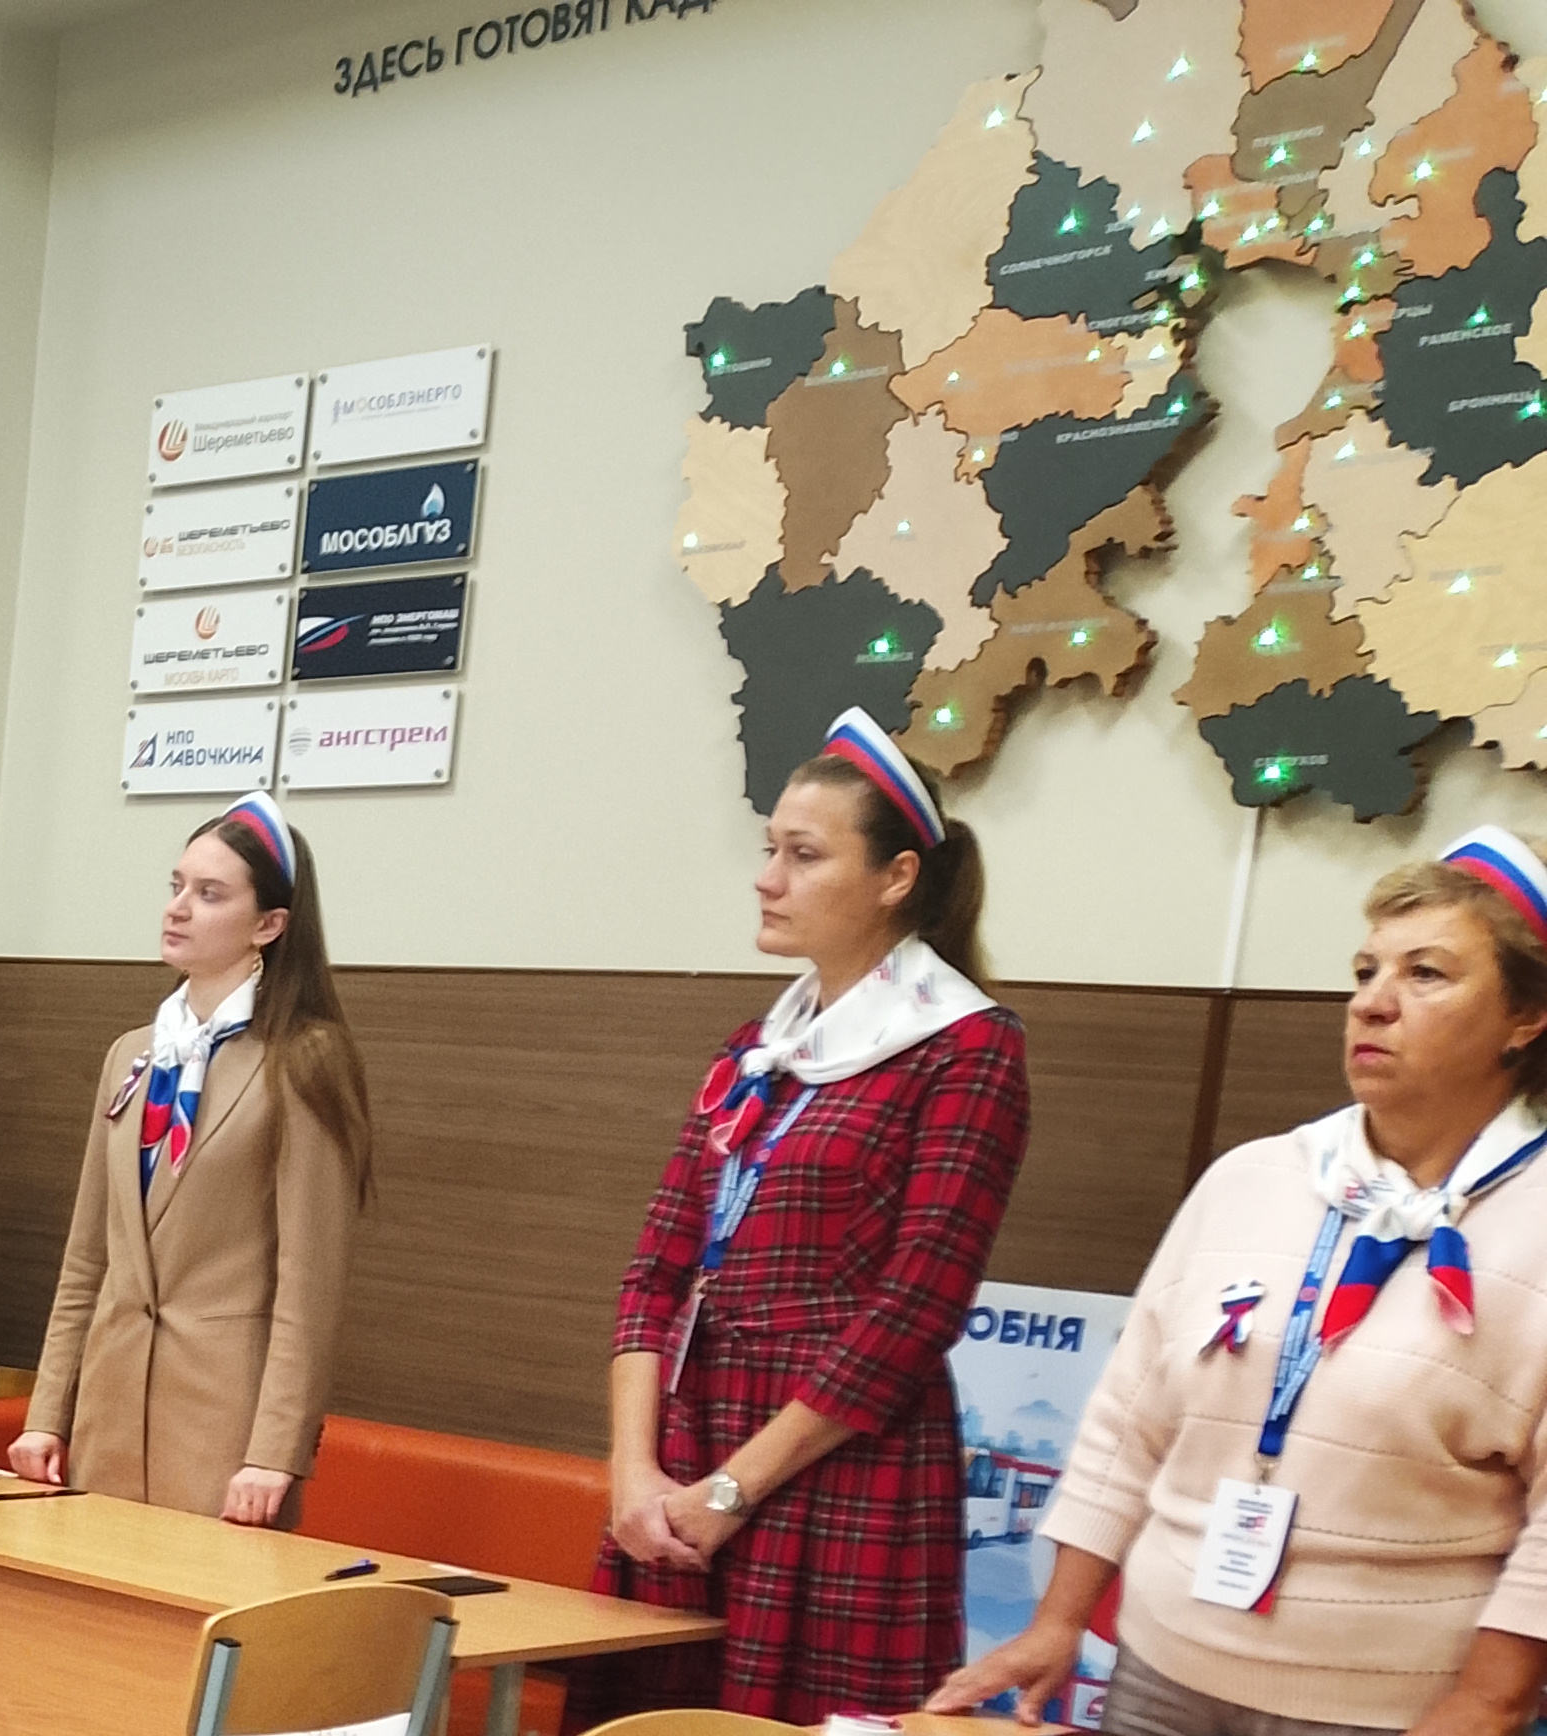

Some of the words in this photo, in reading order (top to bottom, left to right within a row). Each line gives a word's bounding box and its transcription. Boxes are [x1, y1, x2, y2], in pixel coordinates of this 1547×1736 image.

[334, 36, 444, 98] ЗДЕСЬ
[455, 0, 610, 65] ГОТОВЯТ
[1418, 322, 1515, 347] РАМЕНСКОЕ
[342, 384, 463, 414] МОСОБЛЭНЕРГО
[193, 426, 294, 453] Шереметьево
[178, 519, 290, 541] ШЕРЕМЕТЬЕВО
[319, 518, 451, 555] МОСОБЛГАЗ
[143, 643, 269, 665] ШЕРЕМЕТЬЕВО
[166, 730, 194, 745] НПО
[319, 725, 448, 752] ангстрем
[158, 746, 265, 768] ЛАВОЧКИНА
[965, 1306, 1086, 1353] ОБНЯ
